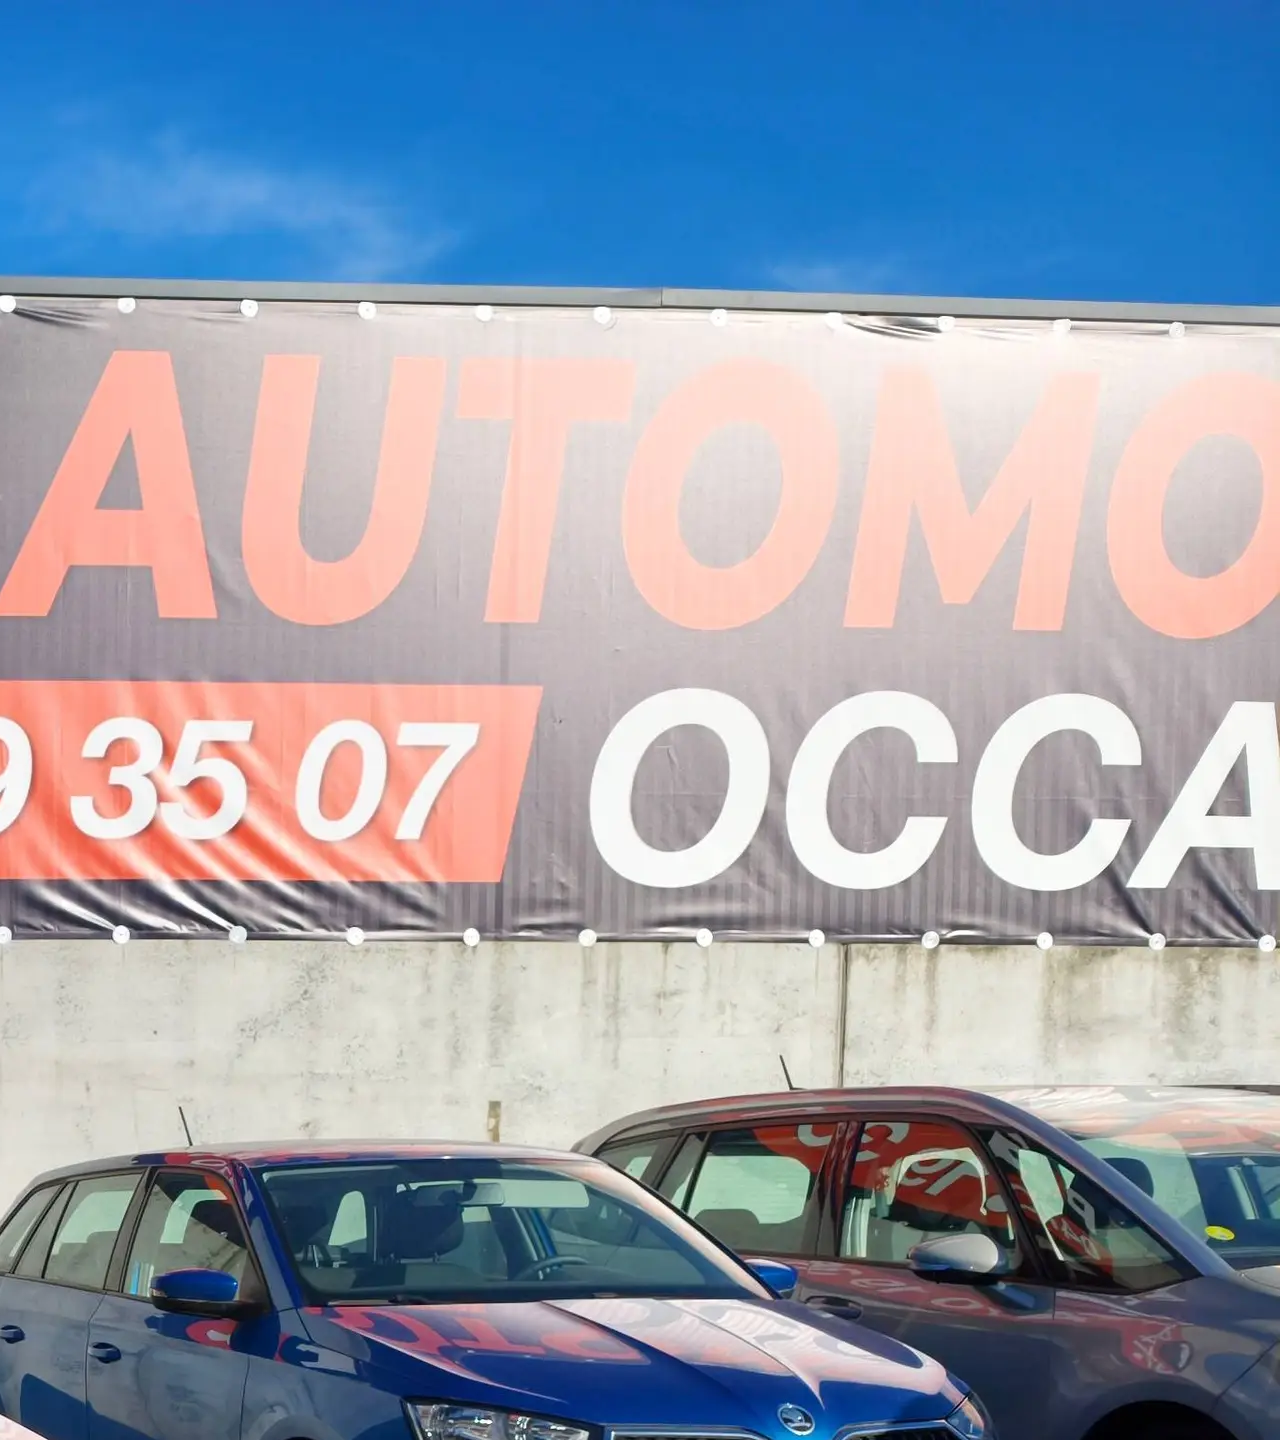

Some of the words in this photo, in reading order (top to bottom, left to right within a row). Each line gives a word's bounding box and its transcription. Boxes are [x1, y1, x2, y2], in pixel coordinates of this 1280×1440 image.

[69, 716, 253, 842] 35
[295, 718, 481, 842] 07
[588, 687, 1280, 891] OCCA
